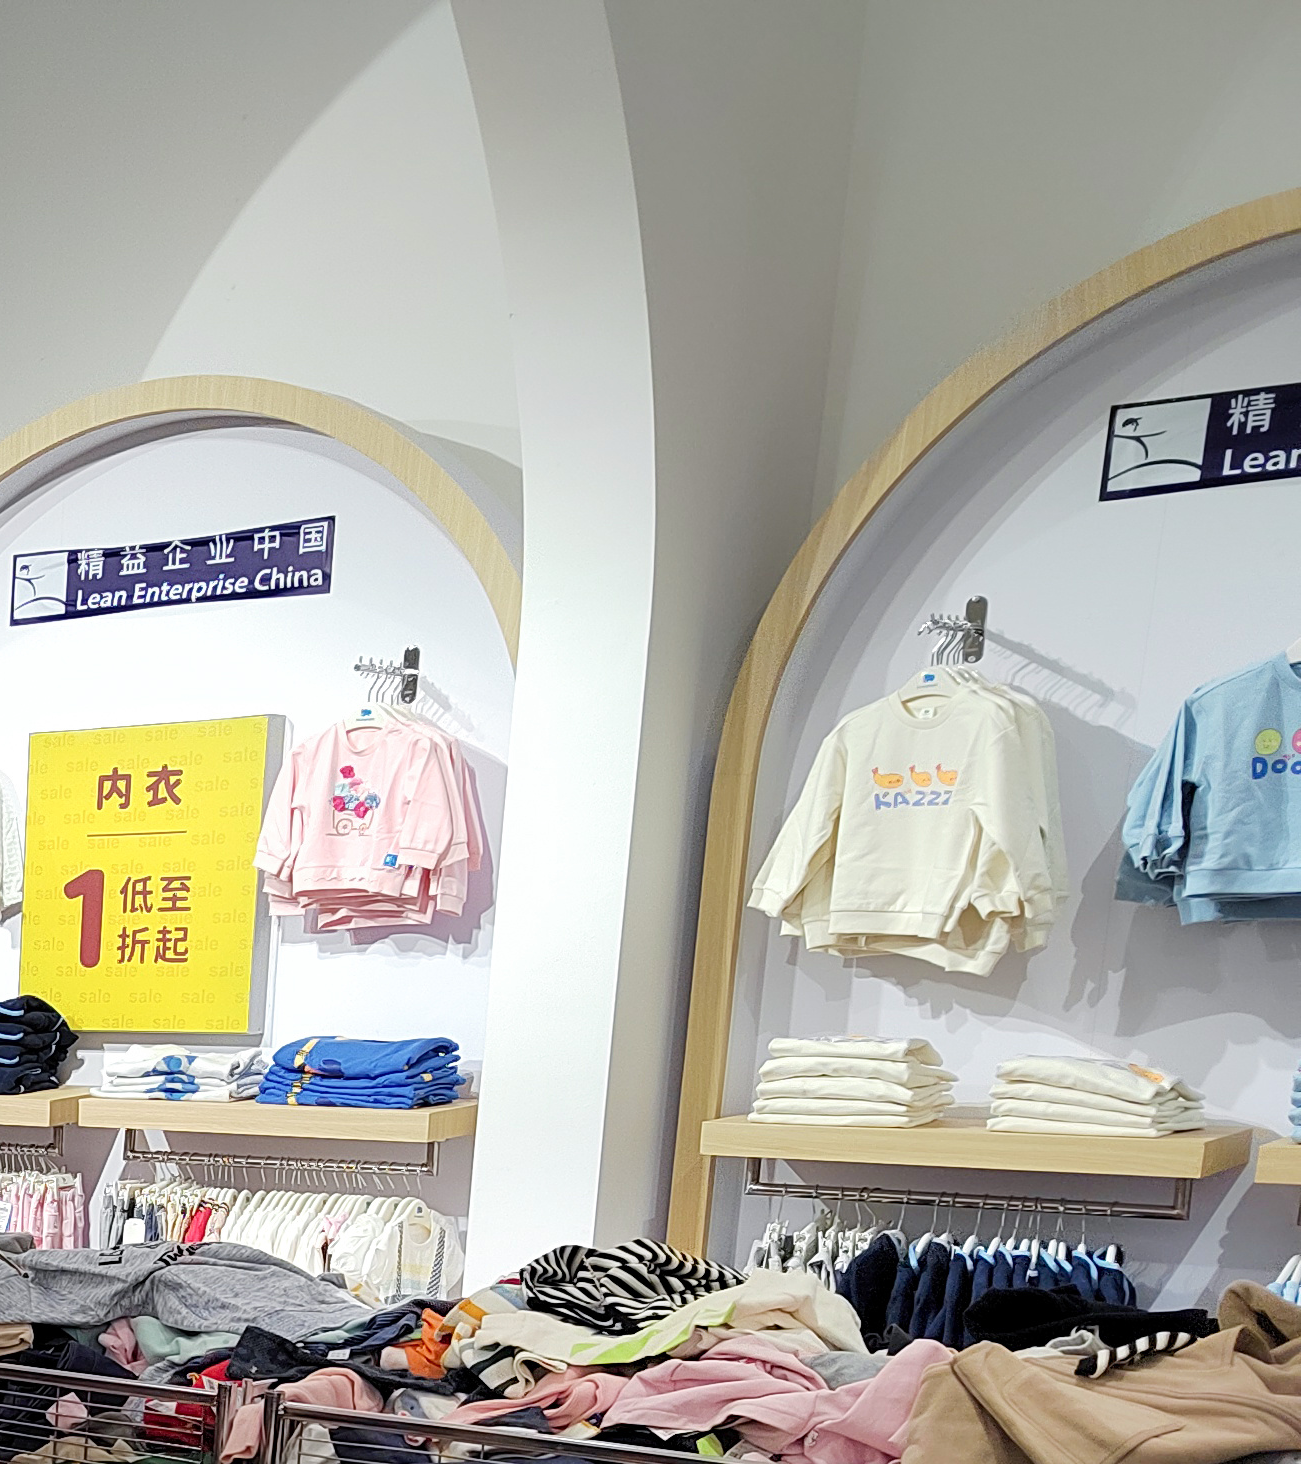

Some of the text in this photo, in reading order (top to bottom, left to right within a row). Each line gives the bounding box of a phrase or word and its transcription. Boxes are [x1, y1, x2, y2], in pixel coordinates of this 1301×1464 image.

[1226, 391, 1276, 436] 精
[77, 521, 329, 581] 精益企业中国
[76, 566, 323, 611] Lean Enterprise China
[97, 764, 183, 810] 内衣
[120, 876, 192, 913] 低至
[64, 869, 104, 968] 1
[117, 927, 189, 964] 折起
